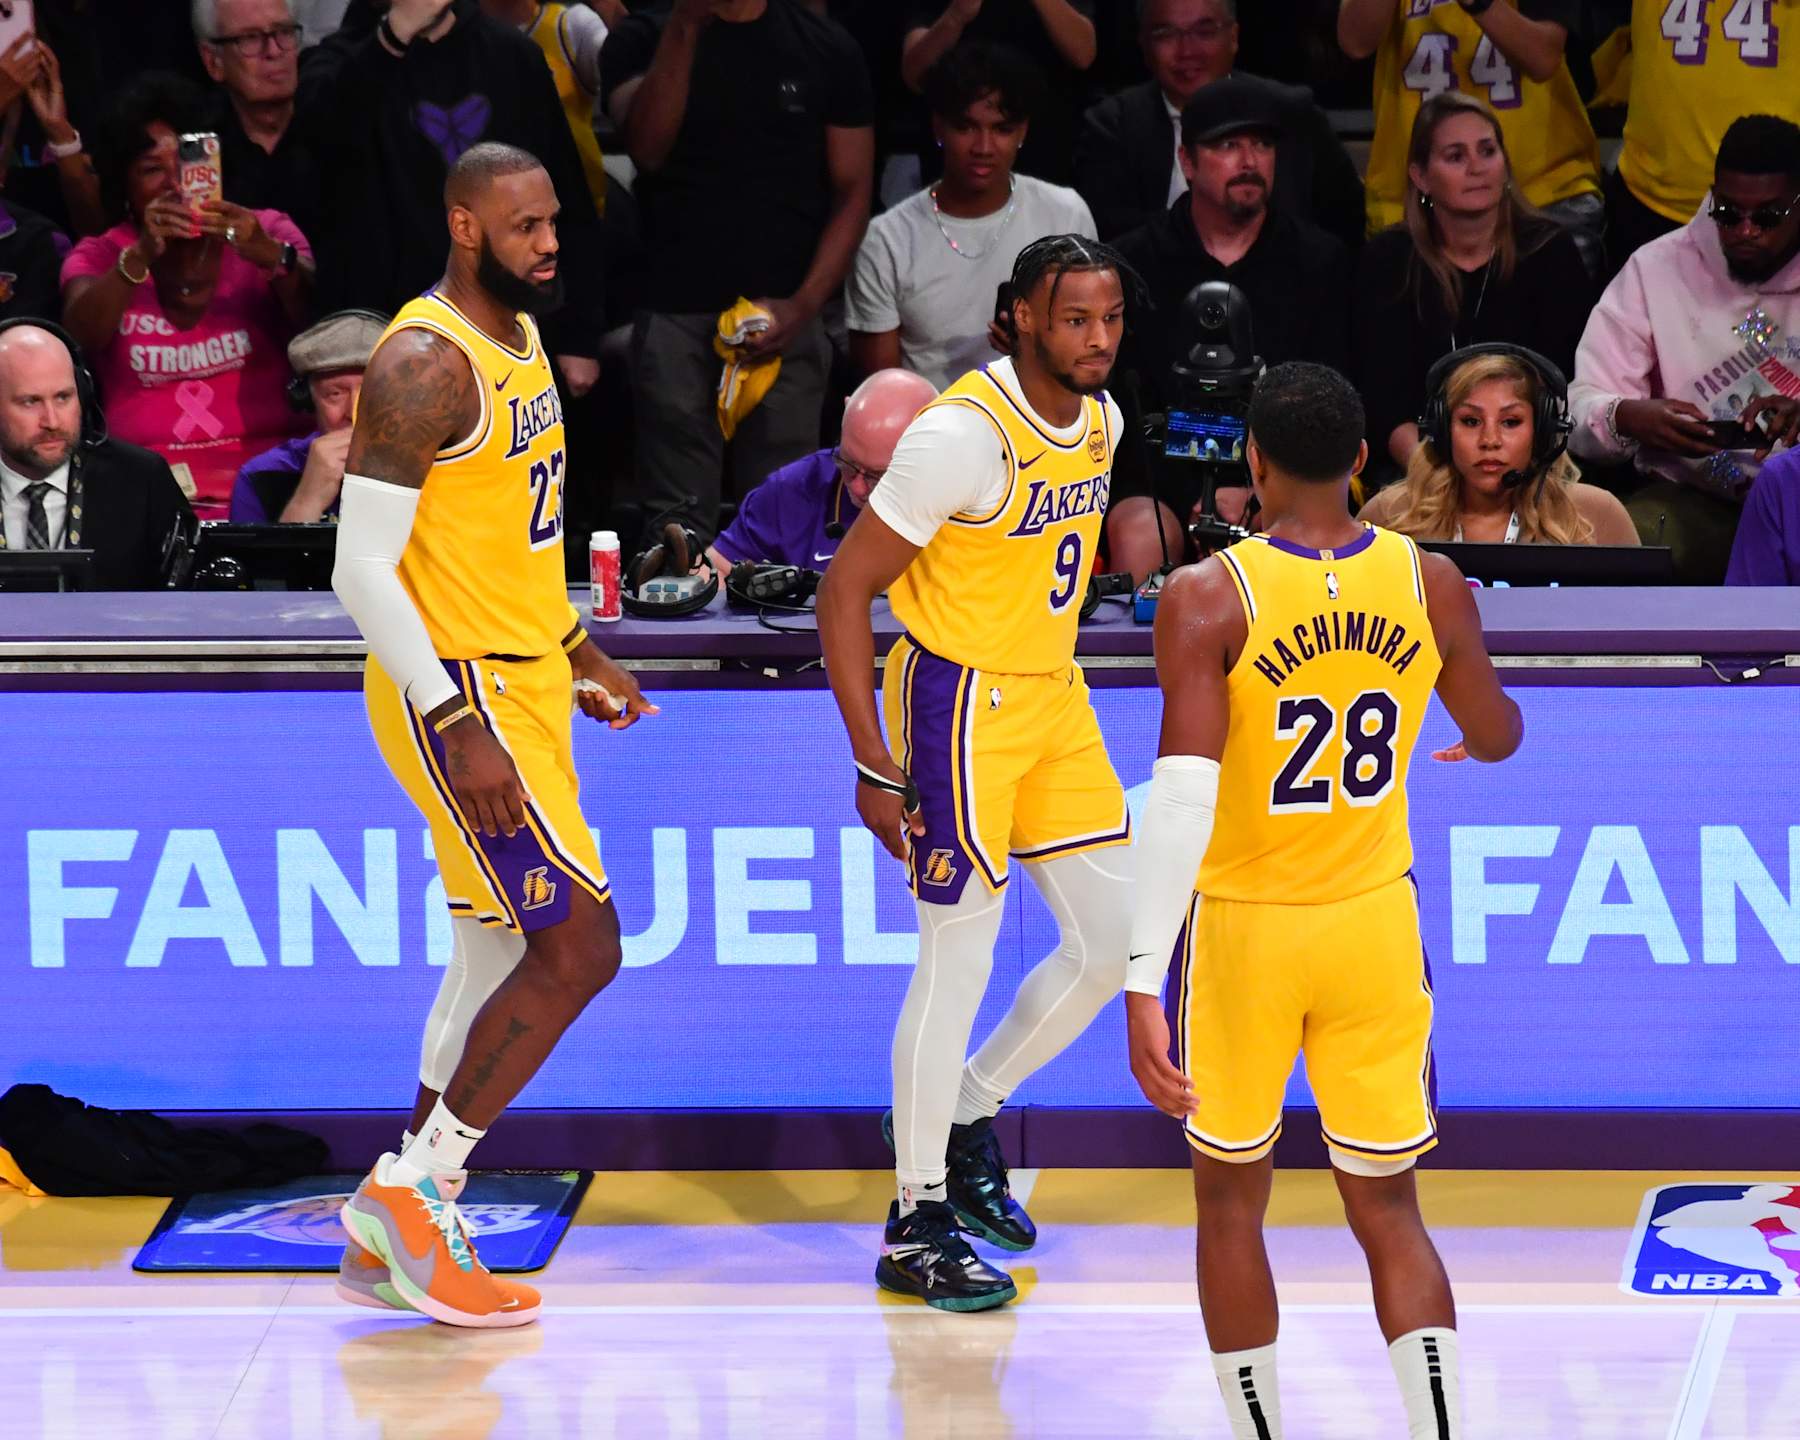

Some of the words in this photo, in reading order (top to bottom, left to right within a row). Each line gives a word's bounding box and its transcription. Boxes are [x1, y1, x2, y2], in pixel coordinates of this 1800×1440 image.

[1661, 0, 1778, 67] 44
[1403, 32, 1523, 109] 44
[184, 165, 218, 190] USC
[119, 313, 175, 337] USC
[129, 328, 253, 374] STRONGER
[1006, 471, 1110, 537] LAKERS
[1048, 531, 1082, 616] 9
[1253, 611, 1422, 688] HACHIMURA
[1268, 688, 1401, 815] 28
[27, 826, 919, 968] FANUEL
[1450, 825, 1800, 964] FAN
[1651, 1273, 1768, 1290] NBA
